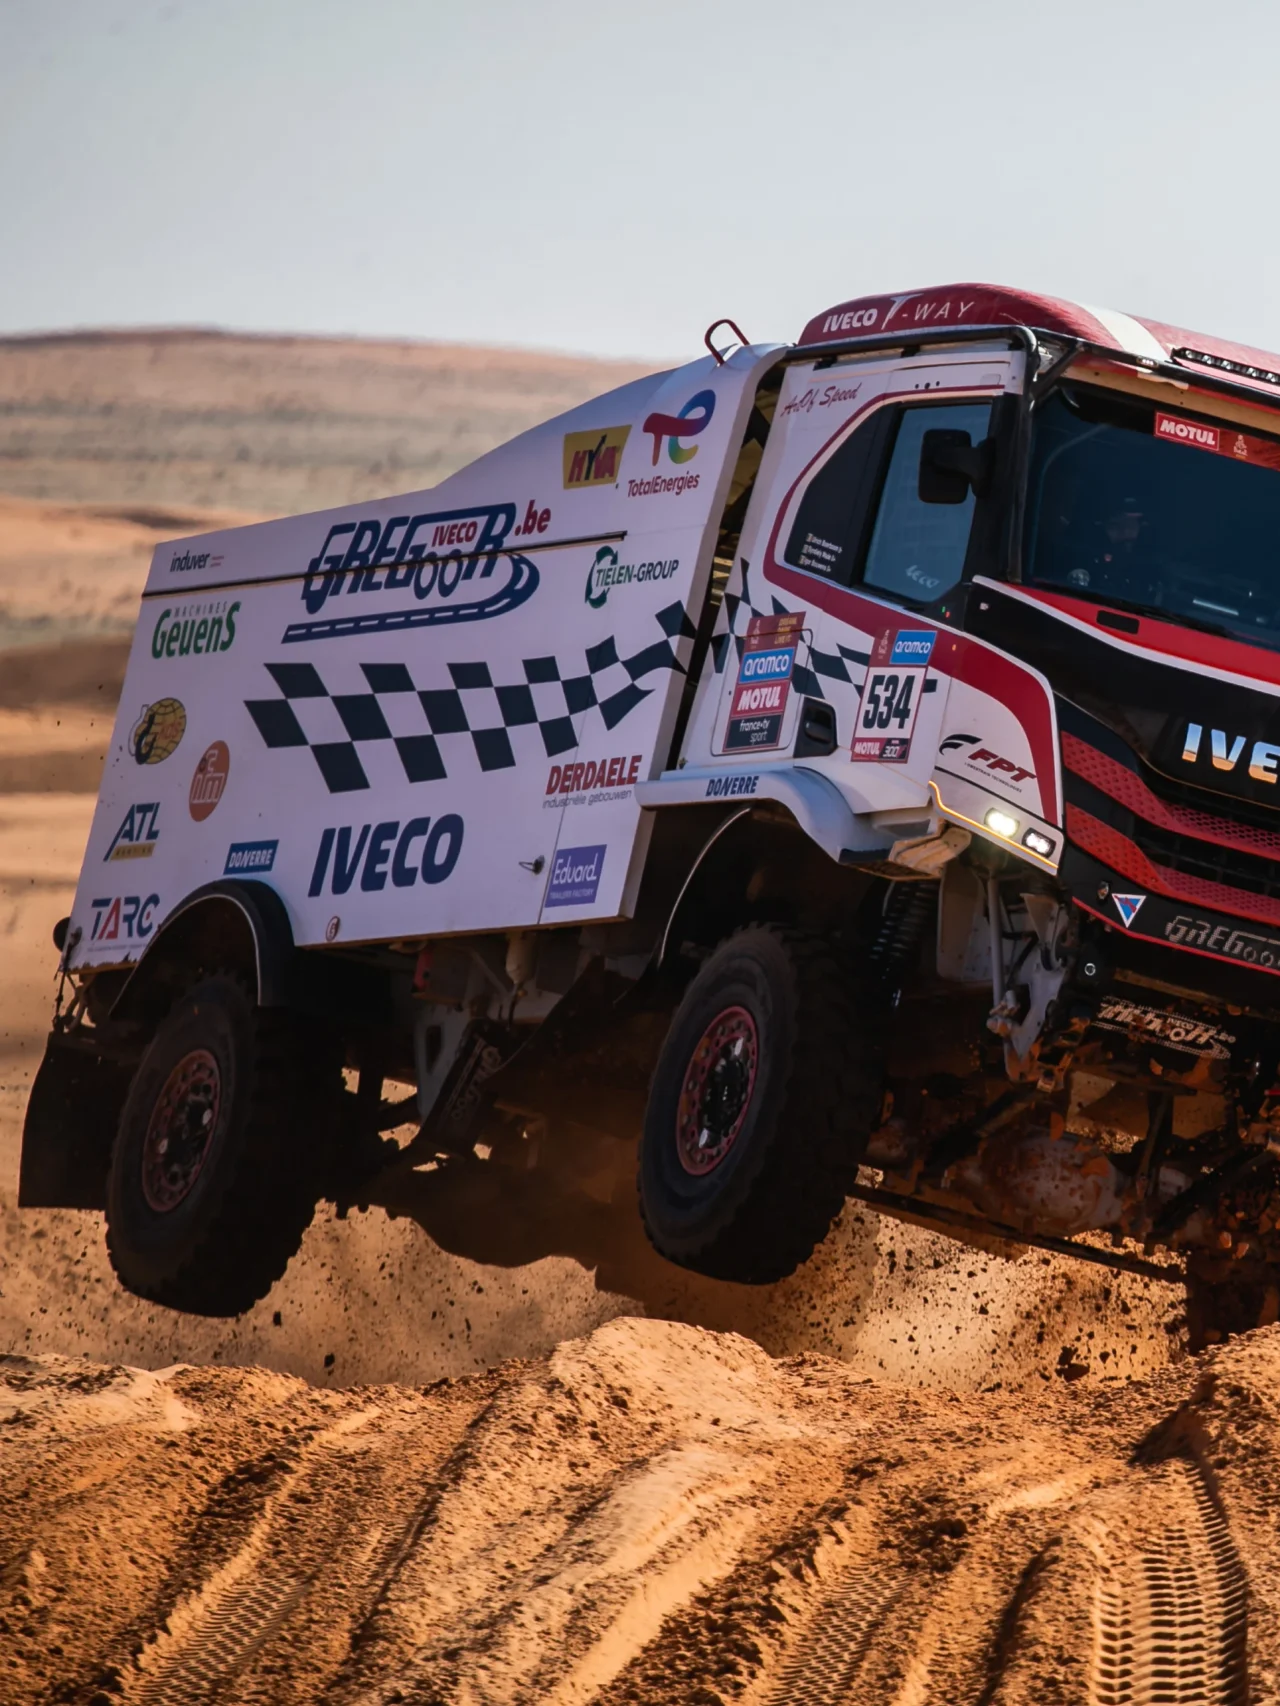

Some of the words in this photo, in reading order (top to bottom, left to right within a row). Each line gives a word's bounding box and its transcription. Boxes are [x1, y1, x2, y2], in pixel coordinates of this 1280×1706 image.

[823, 308, 877, 333] IVECO
[819, 382, 862, 408] Speed
[1160, 419, 1216, 446] MOTUL
[628, 471, 701, 497] TotalEnergies
[431, 521, 478, 547] IVECO
[170, 549, 210, 572] induver
[595, 559, 680, 587] TIELEN-GROUP
[174, 601, 227, 618] MACHINES
[895, 641, 931, 654] aramco
[743, 654, 790, 677] aramco
[737, 686, 782, 711] MOTUL
[862, 674, 915, 729] 534
[749, 730, 768, 746] sport
[853, 741, 880, 755] MOTUL
[545, 754, 642, 796] DERDAELE
[968, 748, 1037, 783] FPT
[588, 789, 632, 806] gebouwen
[103, 802, 160, 862] ATL
[308, 813, 465, 898] IVECO
[552, 853, 599, 885] Eduard
[91, 893, 160, 941] TARC
